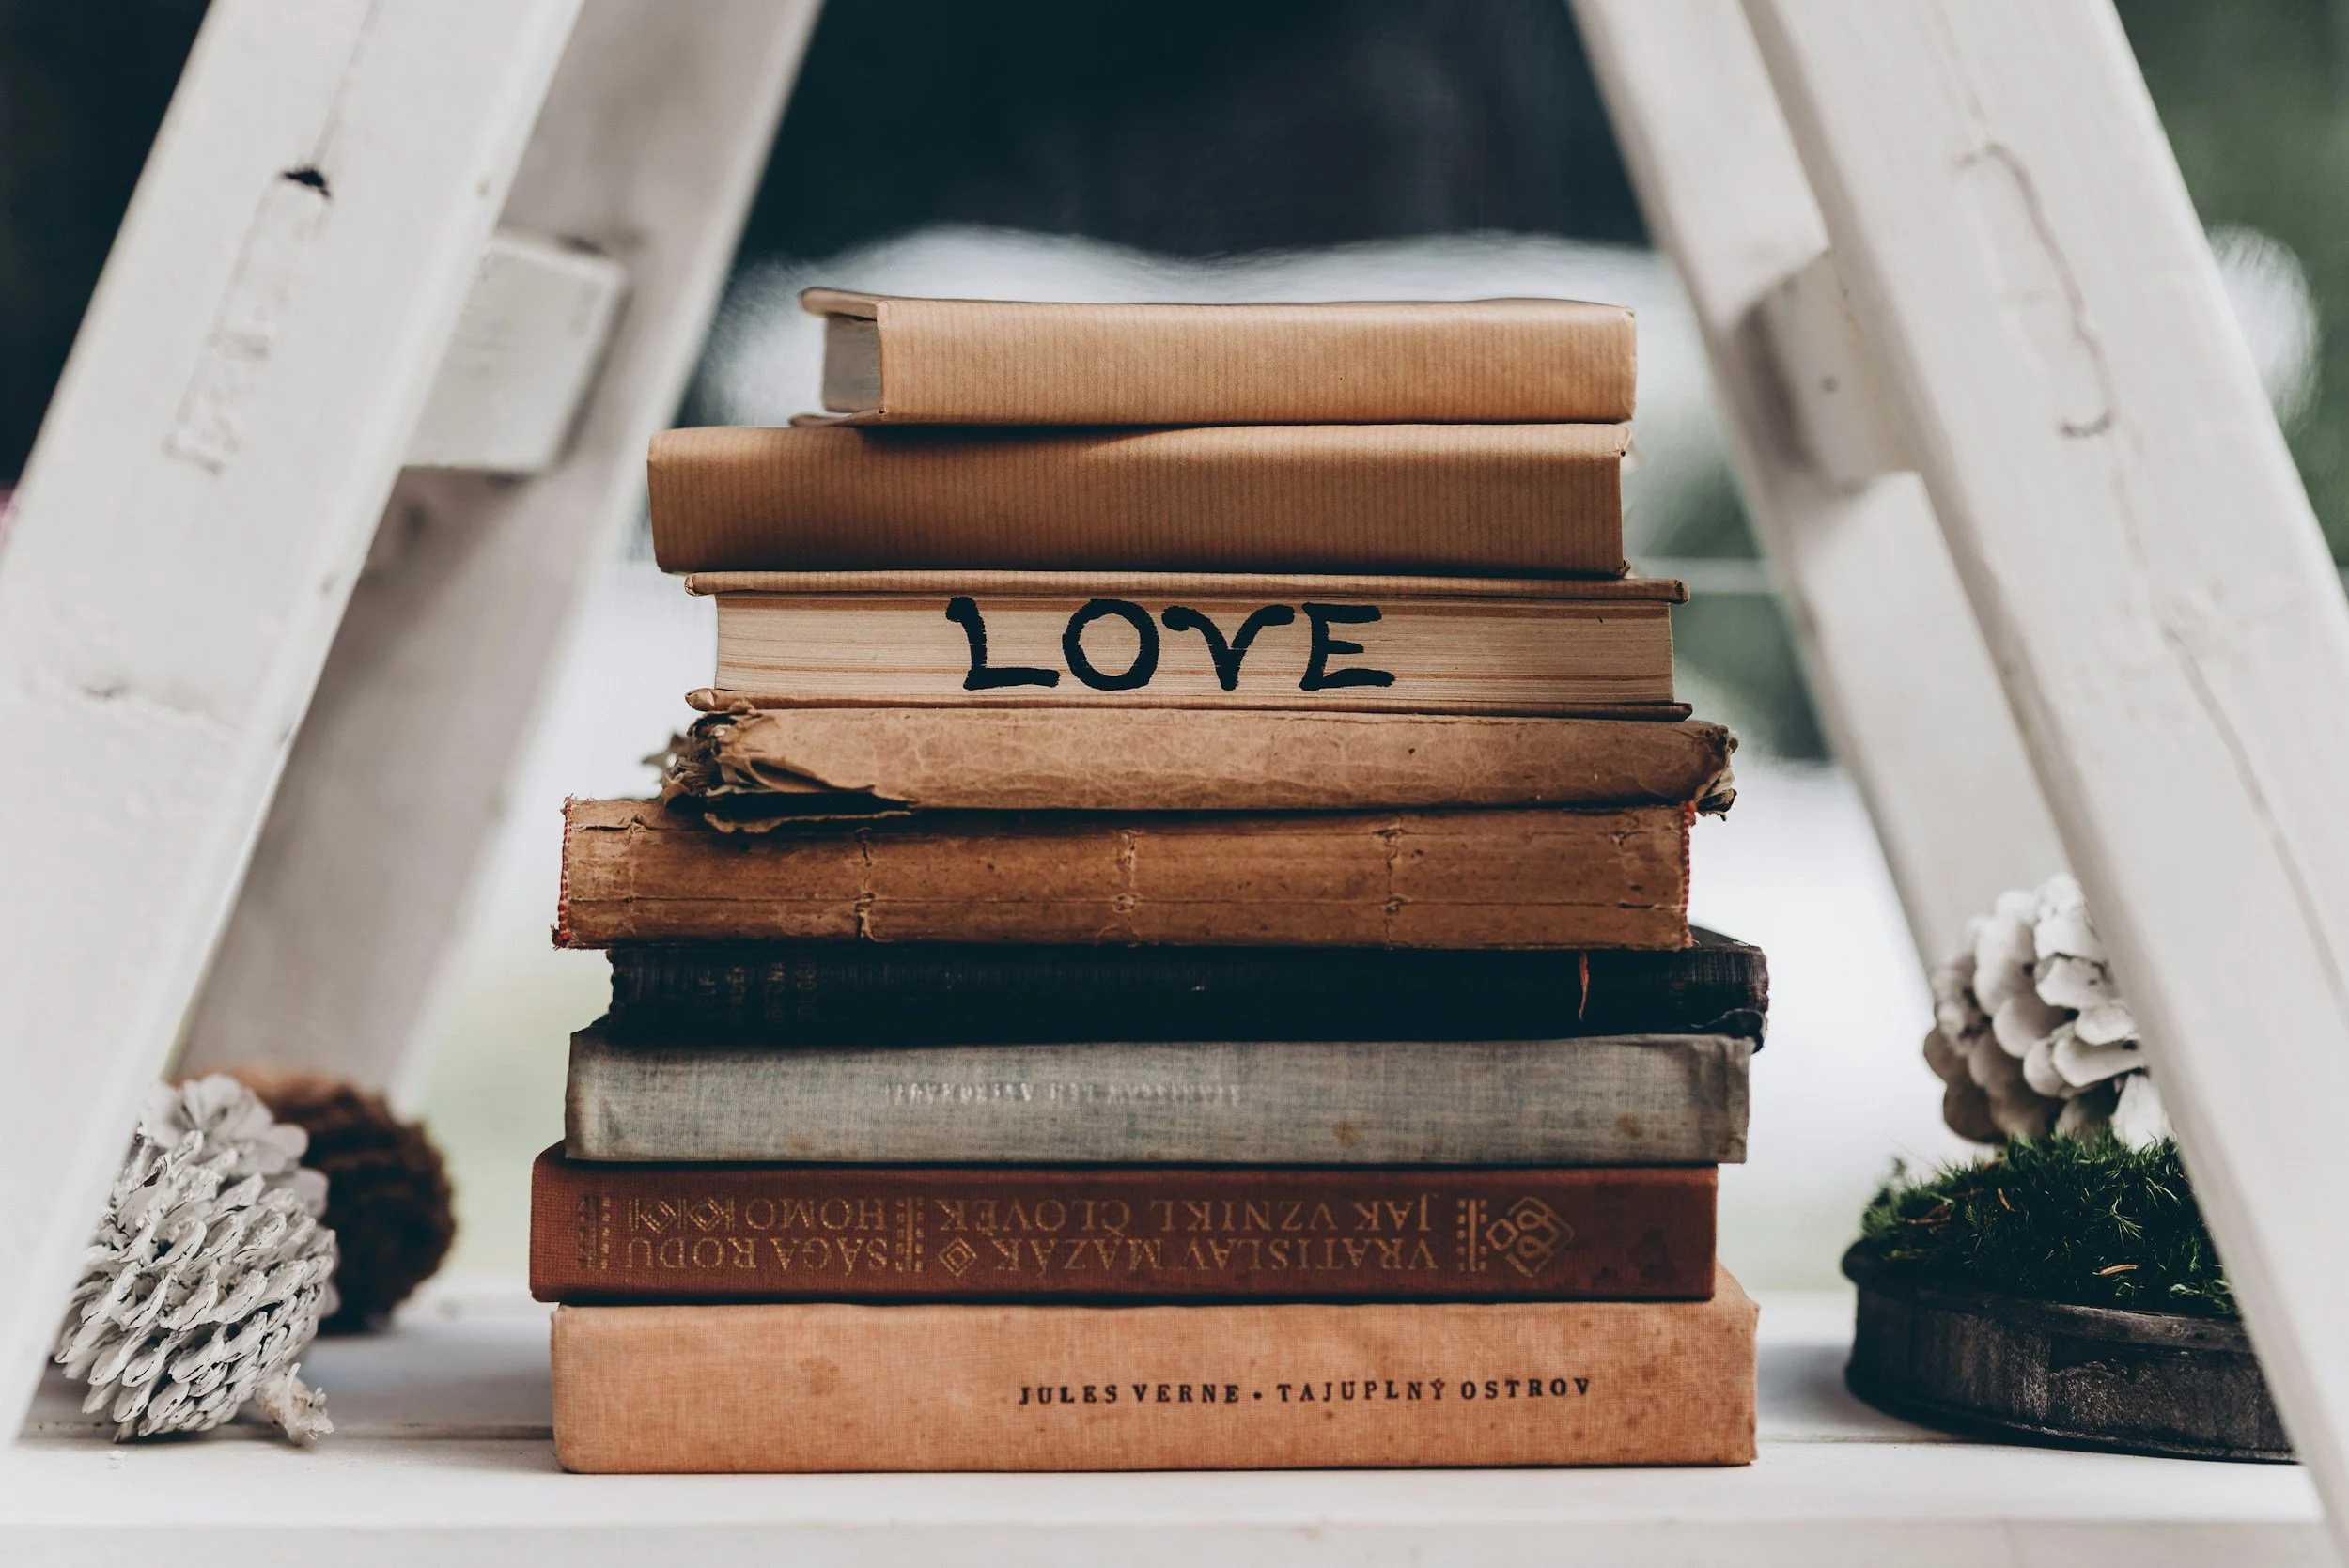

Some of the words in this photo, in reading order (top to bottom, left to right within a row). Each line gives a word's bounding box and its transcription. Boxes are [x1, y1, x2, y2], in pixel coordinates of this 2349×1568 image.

[945, 597, 1397, 691] LOVE
[744, 1197, 888, 1231] HOMO
[935, 1198, 1131, 1237] ČLOVĚK
[1150, 1199, 1338, 1232] VZNIKL
[1351, 1192, 1439, 1232] JAK
[624, 1236, 757, 1270] RODU
[770, 1236, 889, 1276] SÁGA
[992, 1237, 1165, 1277] MAZÁK
[1181, 1237, 1439, 1270] VRATISLAV
[1019, 1384, 1118, 1405] JULES
[1132, 1383, 1240, 1405] VERNE
[1276, 1376, 1446, 1403] TAJUPLNÝ
[1460, 1376, 1590, 1401] OSTROV
